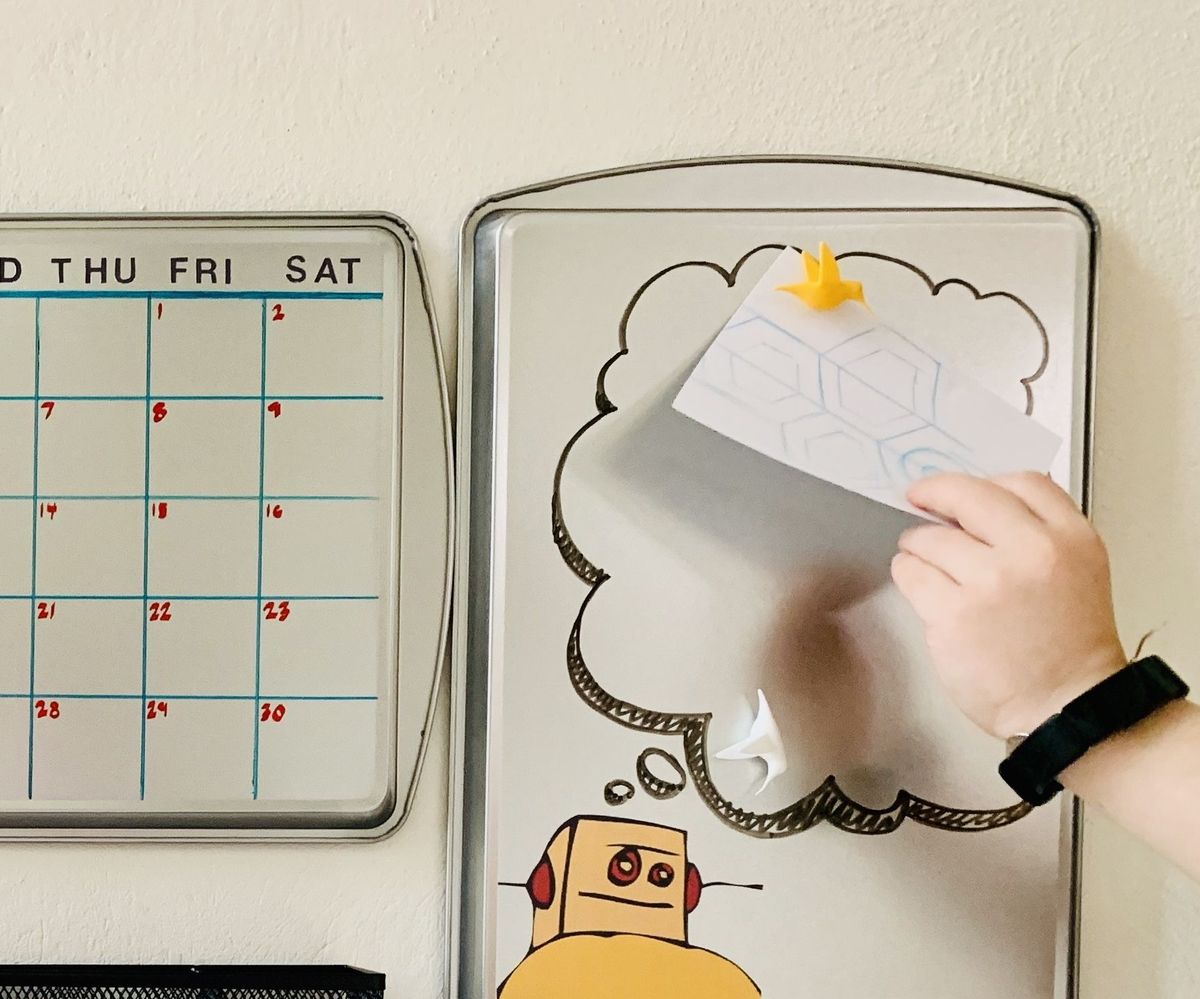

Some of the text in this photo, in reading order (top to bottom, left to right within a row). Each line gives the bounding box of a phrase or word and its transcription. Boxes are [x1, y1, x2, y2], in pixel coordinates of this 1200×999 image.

[50, 257, 136, 284] THU
[170, 257, 232, 285] FRI
[285, 254, 361, 285] SAT
[157, 303, 285, 321] 1 2
[40, 402, 55, 420] 7
[153, 402, 168, 423] 8
[267, 401, 282, 418] 9
[40, 503, 58, 520] 14
[152, 503, 168, 519] 15
[266, 503, 283, 519] 16
[37, 602, 56, 621] 21
[149, 602, 172, 622] 22
[263, 601, 291, 622] 23
[35, 699, 60, 720] 28
[147, 700, 169, 720] 29
[260, 702, 286, 723] 30
